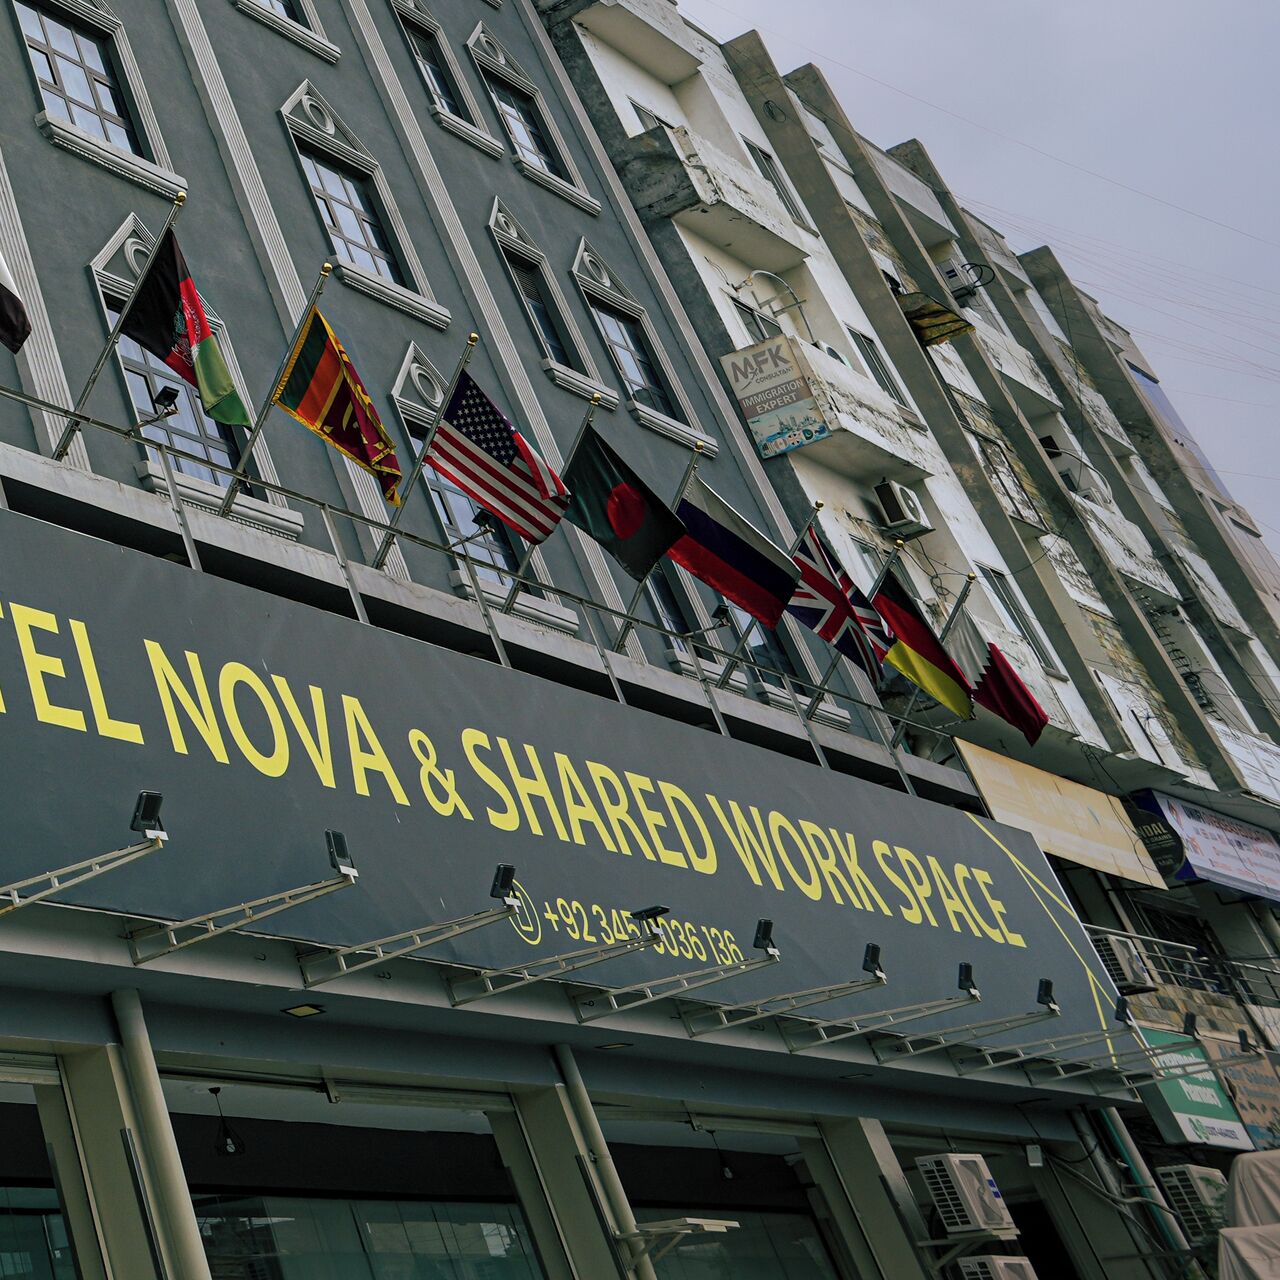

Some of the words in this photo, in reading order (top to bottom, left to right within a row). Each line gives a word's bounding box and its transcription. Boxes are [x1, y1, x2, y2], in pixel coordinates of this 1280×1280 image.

[731, 344, 791, 383] MFK
[742, 379, 805, 408] IMMIGRATION
[756, 392, 798, 414] EXPERT
[143, 638, 411, 806] NOVA
[409, 728, 474, 821] &
[462, 728, 718, 875] SHARED
[704, 793, 893, 917] WORK
[871, 839, 1027, 948] SPACE
[544, 896, 597, 943] +92
[701, 925, 745, 969] 136
